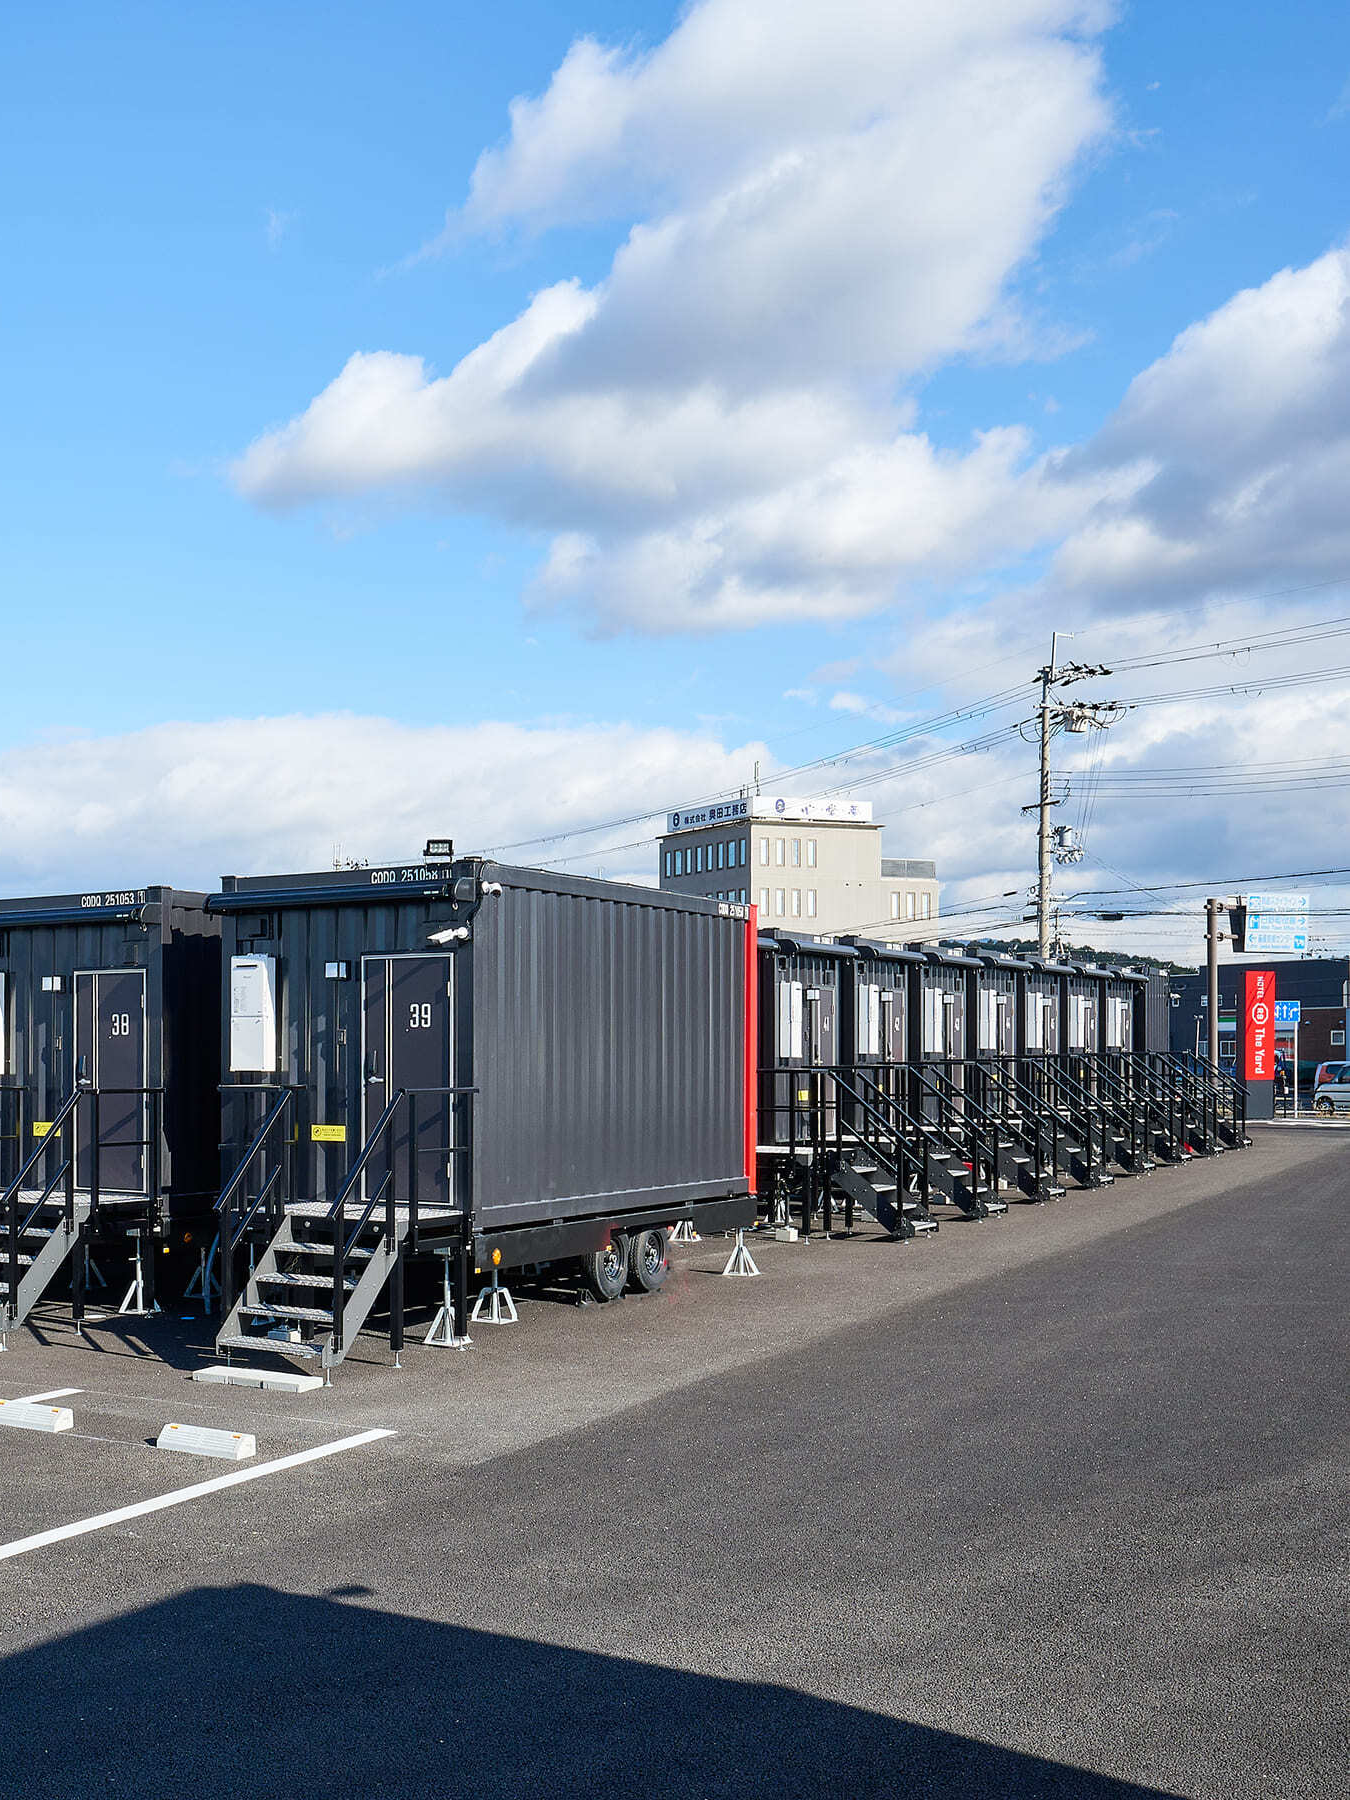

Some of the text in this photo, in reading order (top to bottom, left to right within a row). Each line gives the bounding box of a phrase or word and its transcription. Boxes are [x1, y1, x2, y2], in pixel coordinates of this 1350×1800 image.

[684, 813, 706, 825] 株式会社
[371, 870, 396, 885] CODQ
[81, 895, 102, 908] CODQ
[105, 892, 135, 907] 251053
[1256, 975, 1265, 999] HOTEL
[111, 1013, 130, 1036] 38
[409, 1003, 431, 1028] 39
[1254, 1027, 1266, 1047] The
[1254, 1049, 1266, 1075] Yard
